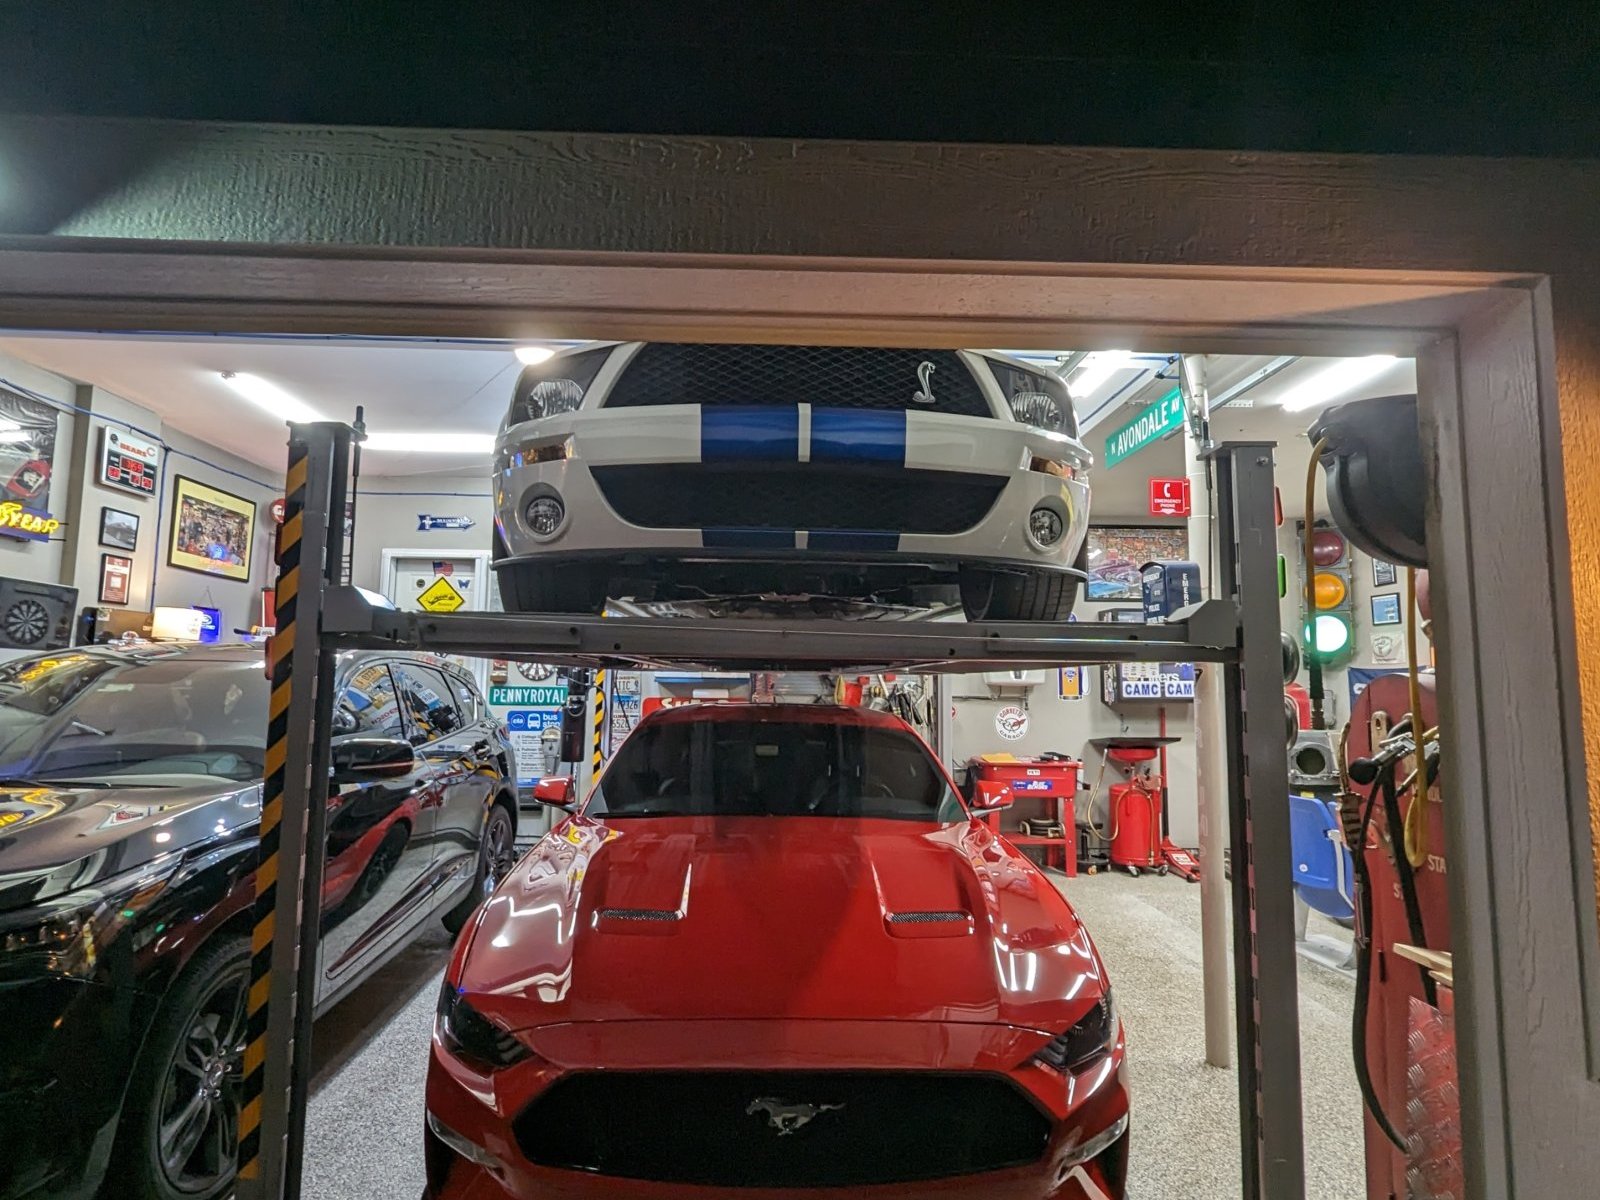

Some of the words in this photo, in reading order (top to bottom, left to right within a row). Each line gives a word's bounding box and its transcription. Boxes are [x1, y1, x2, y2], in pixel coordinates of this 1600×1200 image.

[1111, 442, 1116, 455] N
[1117, 400, 1169, 456] AVONDALE
[1171, 396, 1180, 414] AV
[1124, 684, 1159, 695] CAMC
[1167, 684, 1193, 695] CAM
[492, 689, 566, 703] PENNYROYAL
